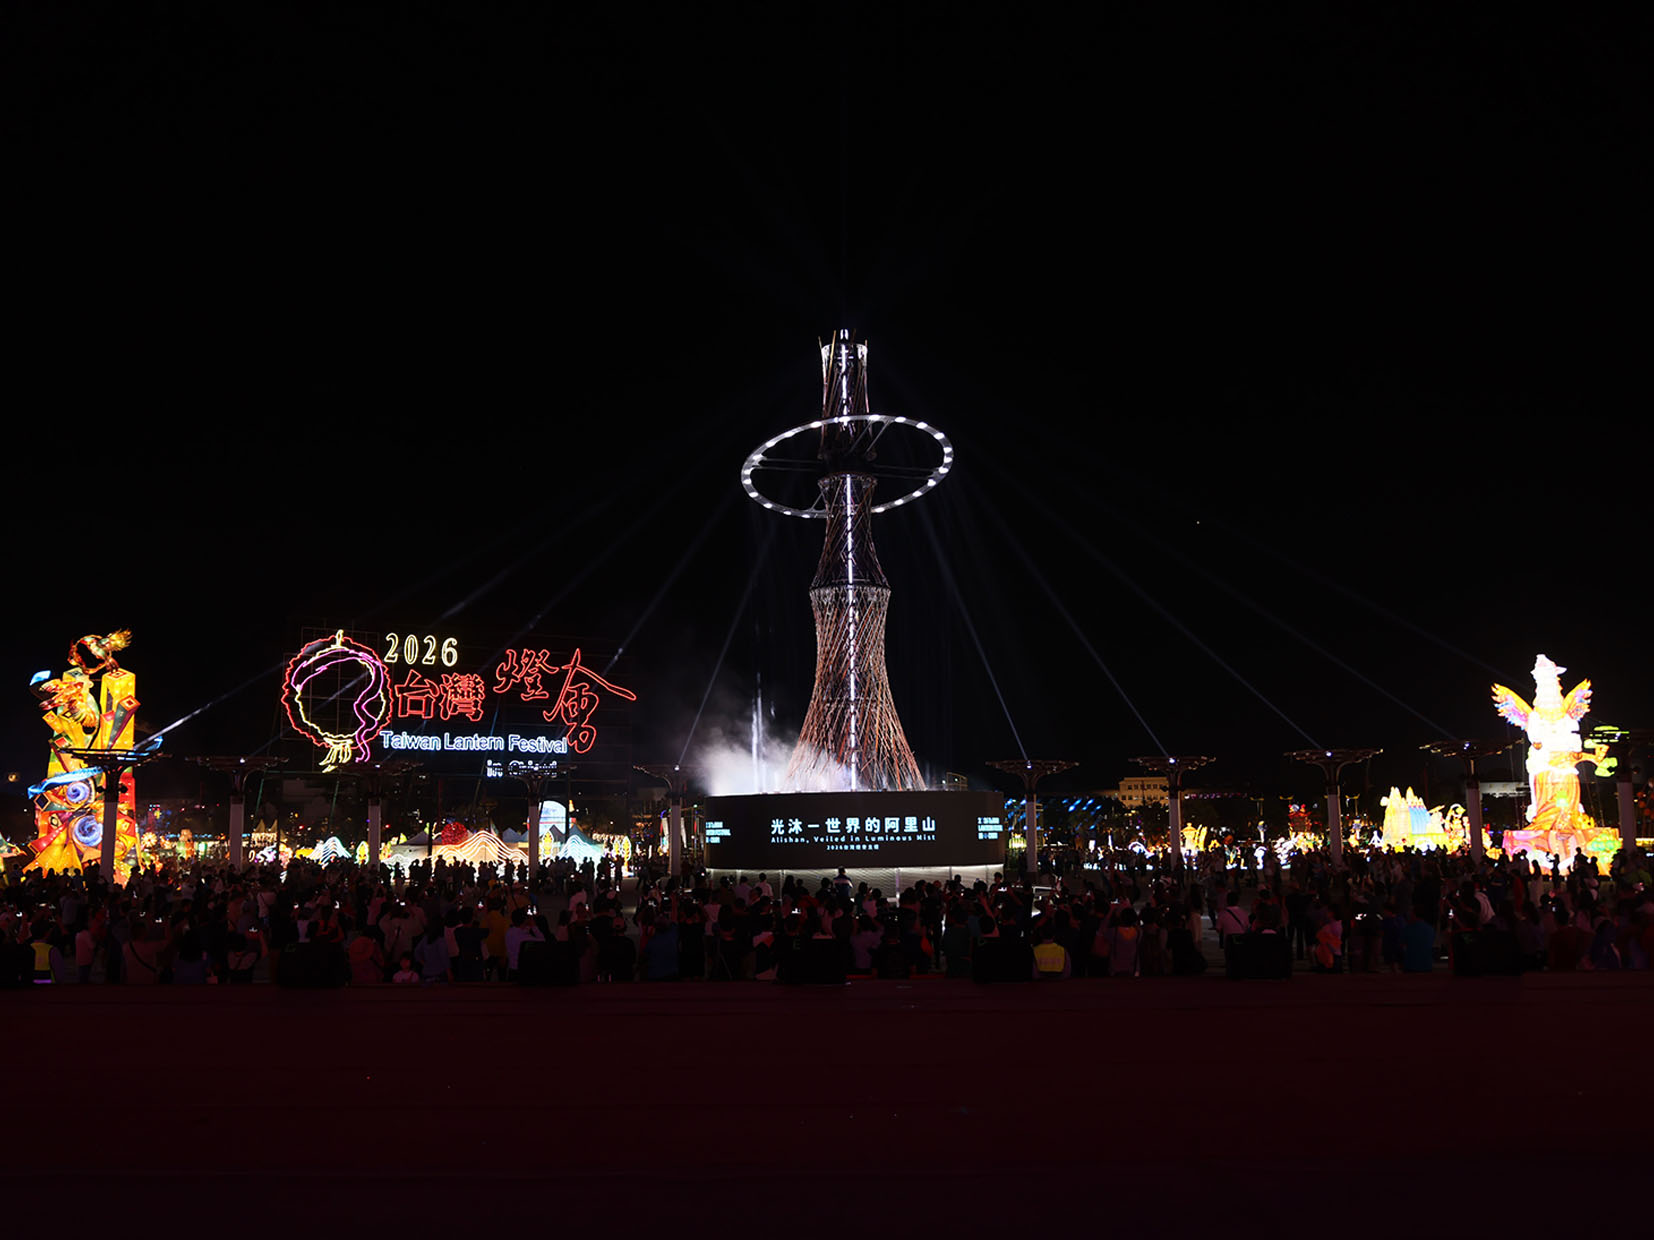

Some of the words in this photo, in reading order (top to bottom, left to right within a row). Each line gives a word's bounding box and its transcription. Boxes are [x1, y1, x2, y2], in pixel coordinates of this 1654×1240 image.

[384, 633, 459, 667] 2026
[380, 730, 441, 751] Taiwan
[445, 732, 505, 752] Lantern
[508, 734, 568, 754] Festival
[771, 836, 810, 844] Alishan,
